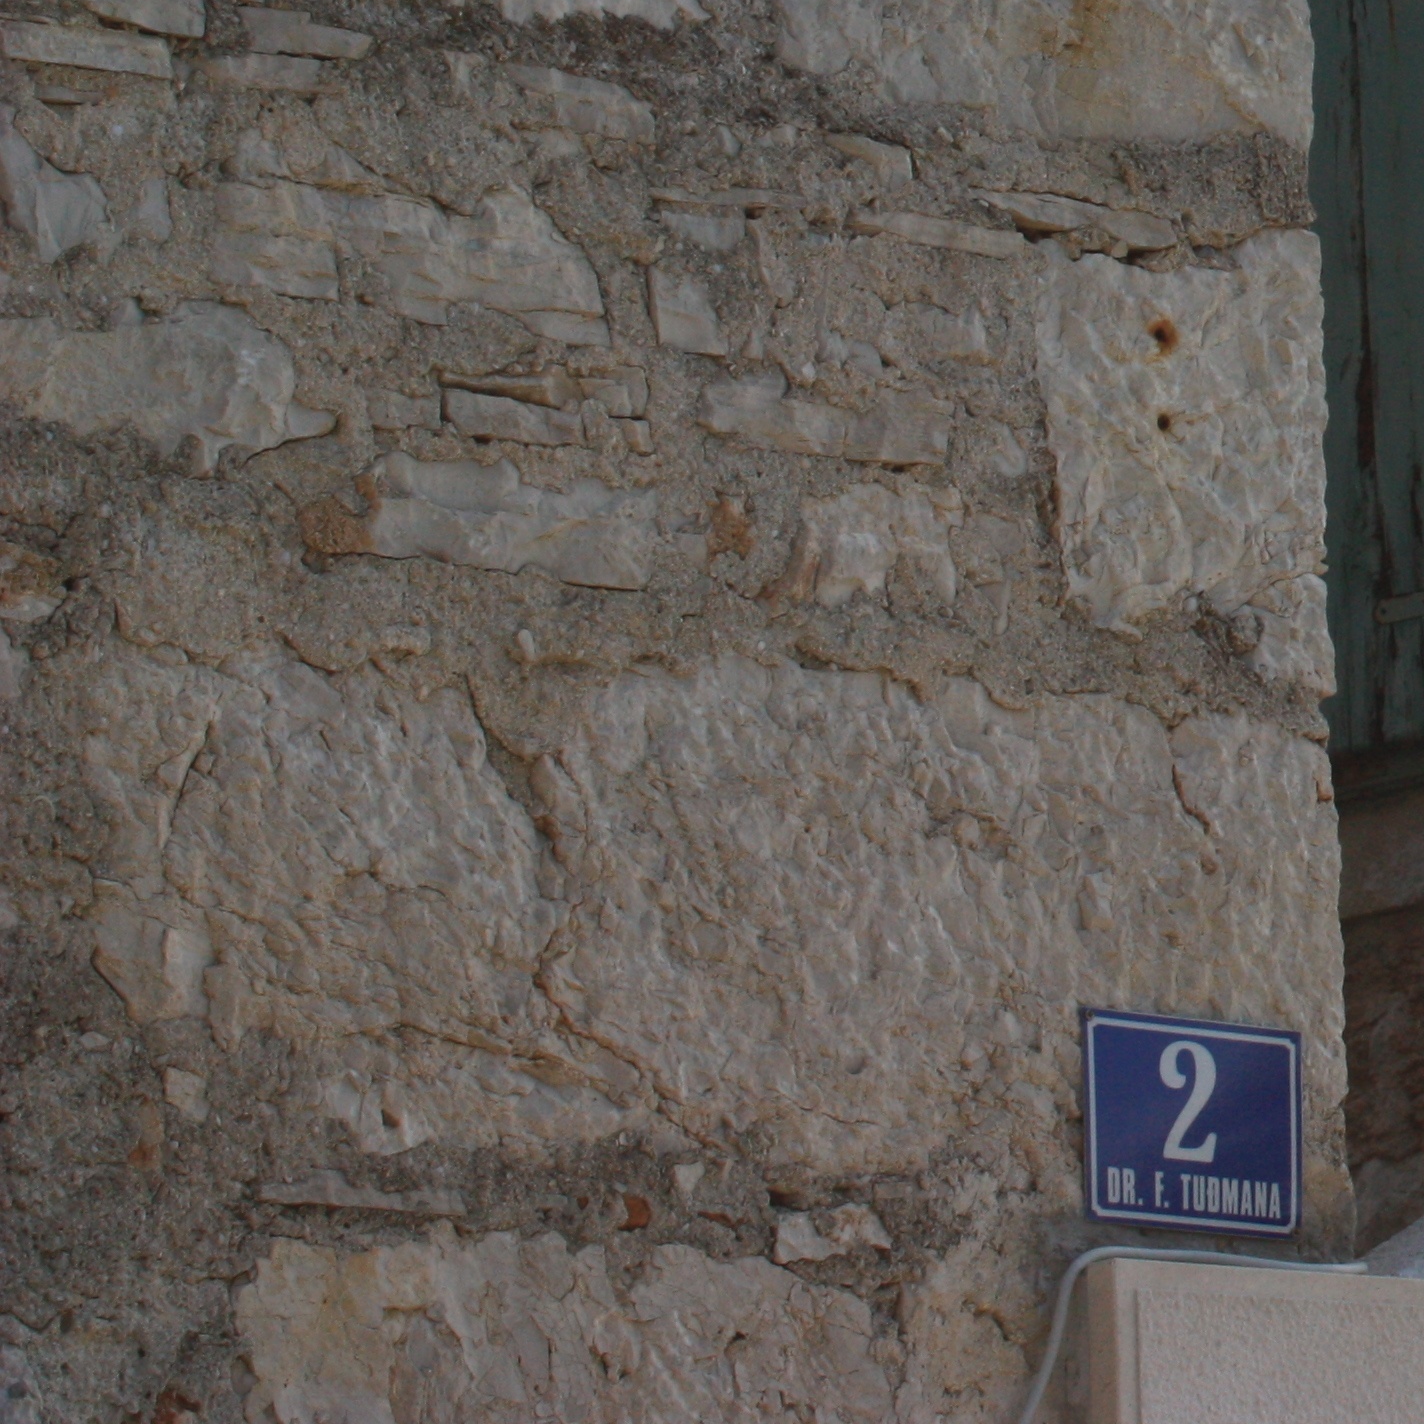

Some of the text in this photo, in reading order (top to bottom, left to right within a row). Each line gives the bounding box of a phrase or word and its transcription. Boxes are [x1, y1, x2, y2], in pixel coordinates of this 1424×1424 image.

[1159, 1040, 1217, 1163] 2
[1107, 1166, 1281, 1219] DR. F. TUĐMANA
